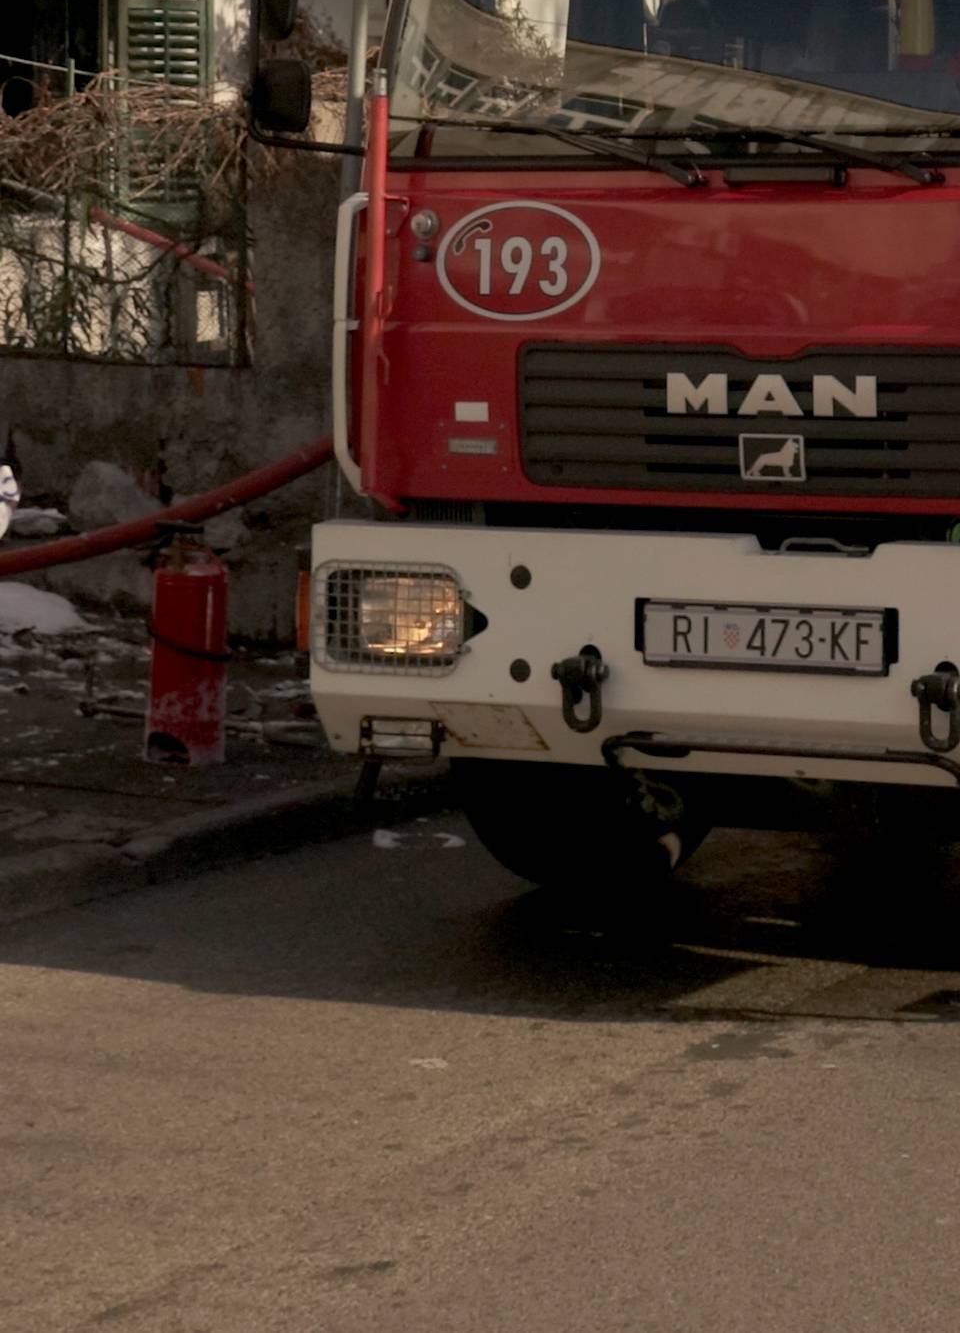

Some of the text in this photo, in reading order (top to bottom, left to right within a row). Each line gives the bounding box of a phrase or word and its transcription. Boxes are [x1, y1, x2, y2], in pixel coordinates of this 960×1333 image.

[474, 236, 568, 296] 193
[666, 372, 878, 418] MAN
[673, 615, 873, 661] RI 473-KF
